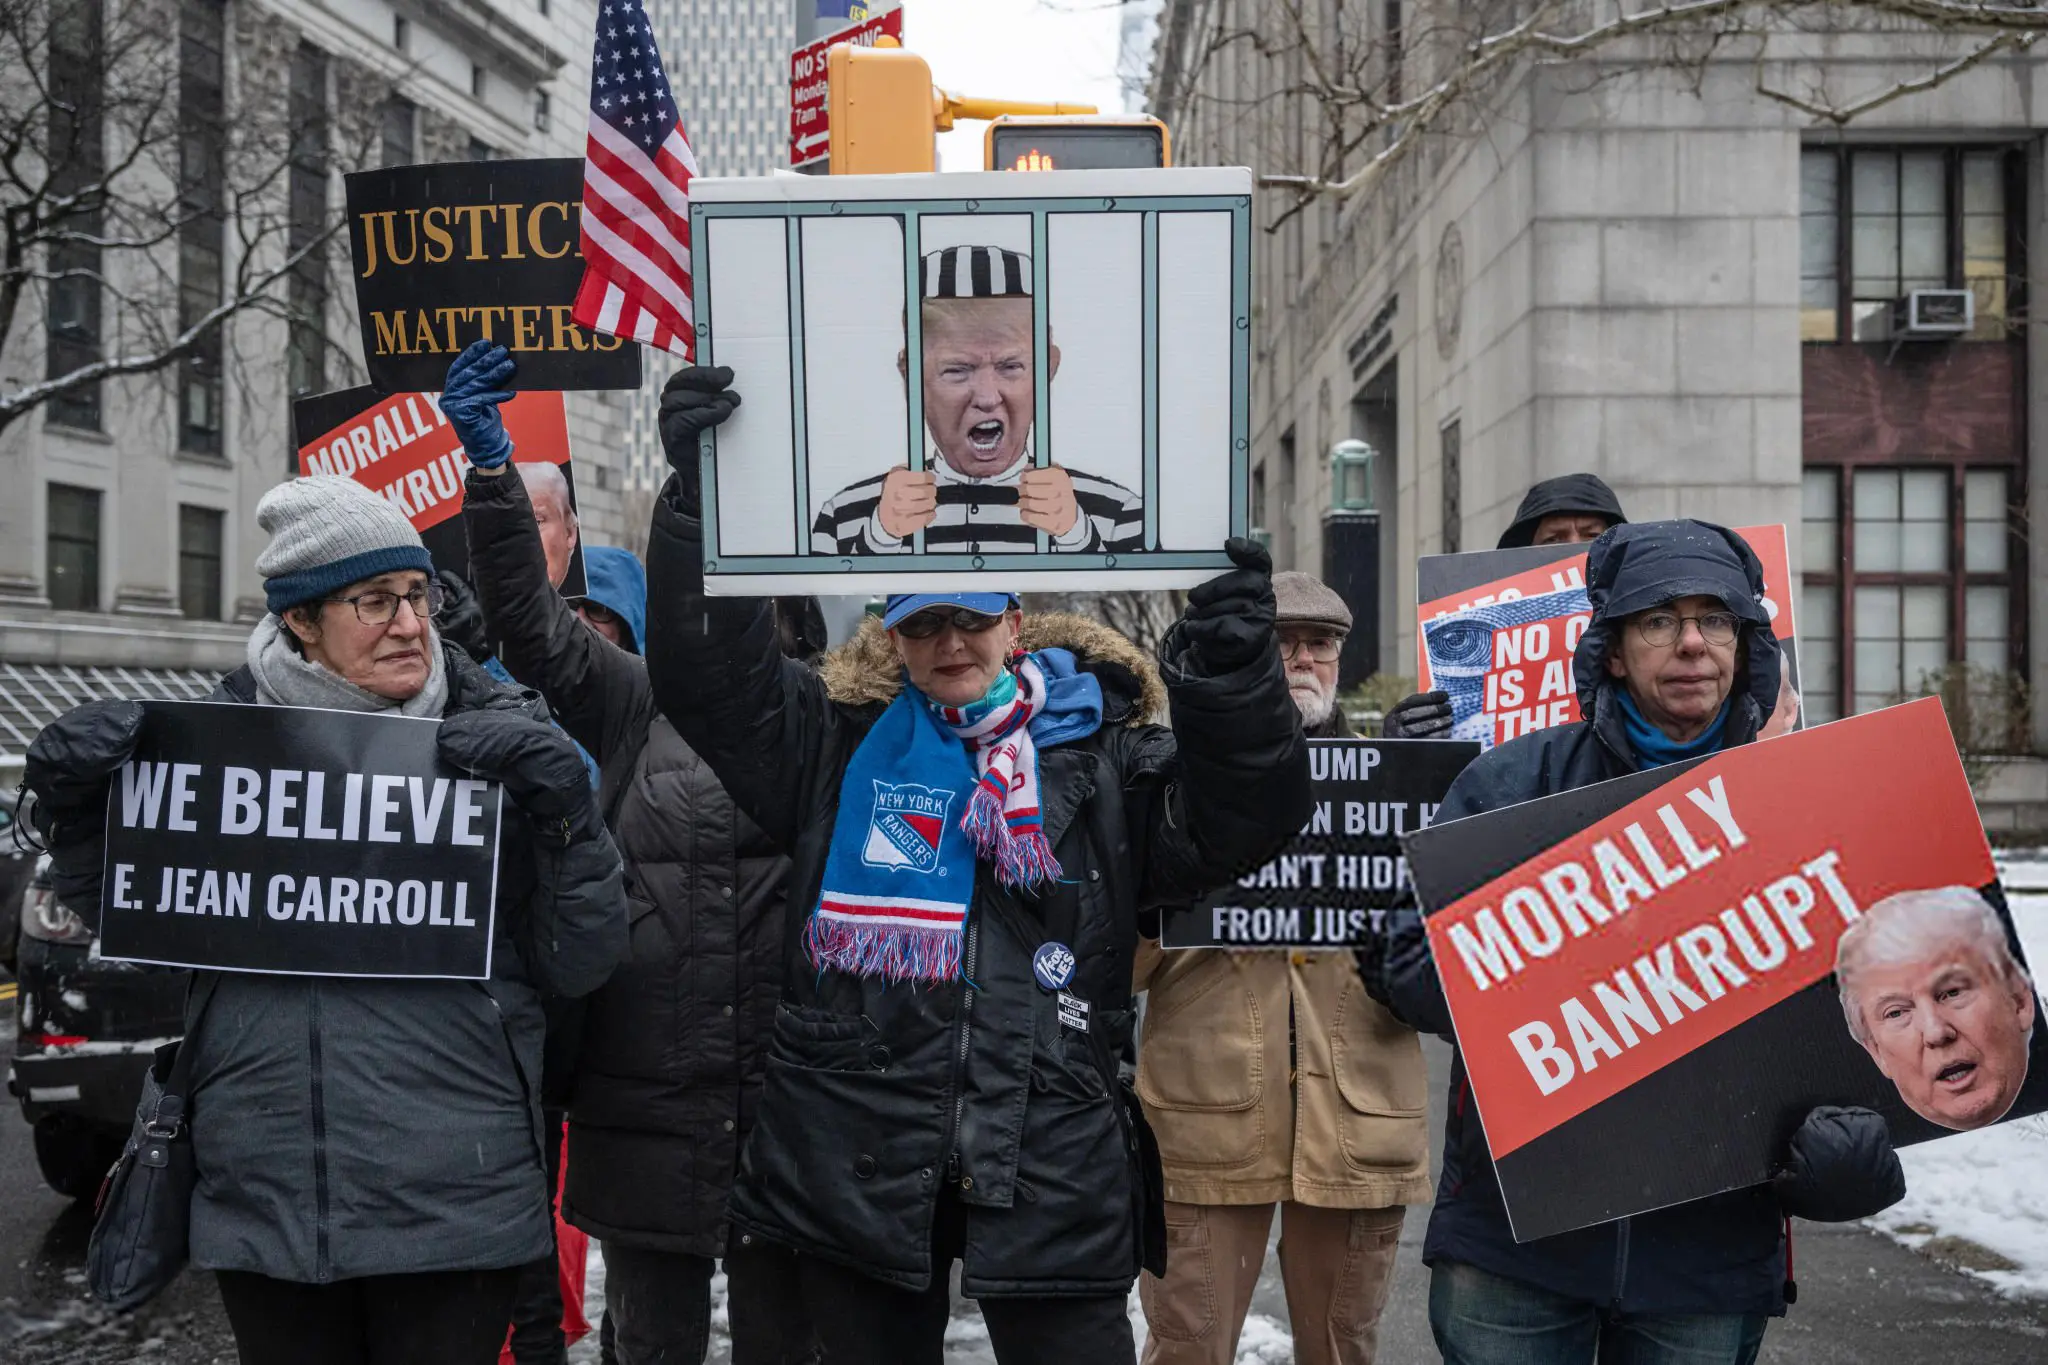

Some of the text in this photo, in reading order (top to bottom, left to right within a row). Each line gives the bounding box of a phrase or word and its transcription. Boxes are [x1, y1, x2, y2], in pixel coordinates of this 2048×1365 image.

[795, 53, 813, 81] NO
[795, 79, 828, 105] Monda
[796, 107, 816, 126] 7am
[1496, 623, 1550, 669] NO
[1487, 669, 1525, 712] IS
[1498, 699, 1571, 740] THE
[1309, 747, 1381, 781] UMP
[121, 760, 488, 847] WE BELIEVE
[878, 792, 943, 814] NEW YORK
[1344, 801, 1408, 837] BUT
[881, 813, 932, 865] RANGERS
[113, 863, 476, 928] E. JEAN CARROLL
[1446, 774, 1750, 992] MORALLY
[1212, 907, 1386, 942] FROM JUST
[1047, 946, 1065, 971] FOX
[1052, 952, 1076, 985] LIES
[1507, 850, 1865, 1097] BANKRUPT
[1061, 1014, 1083, 1028] MATTER
